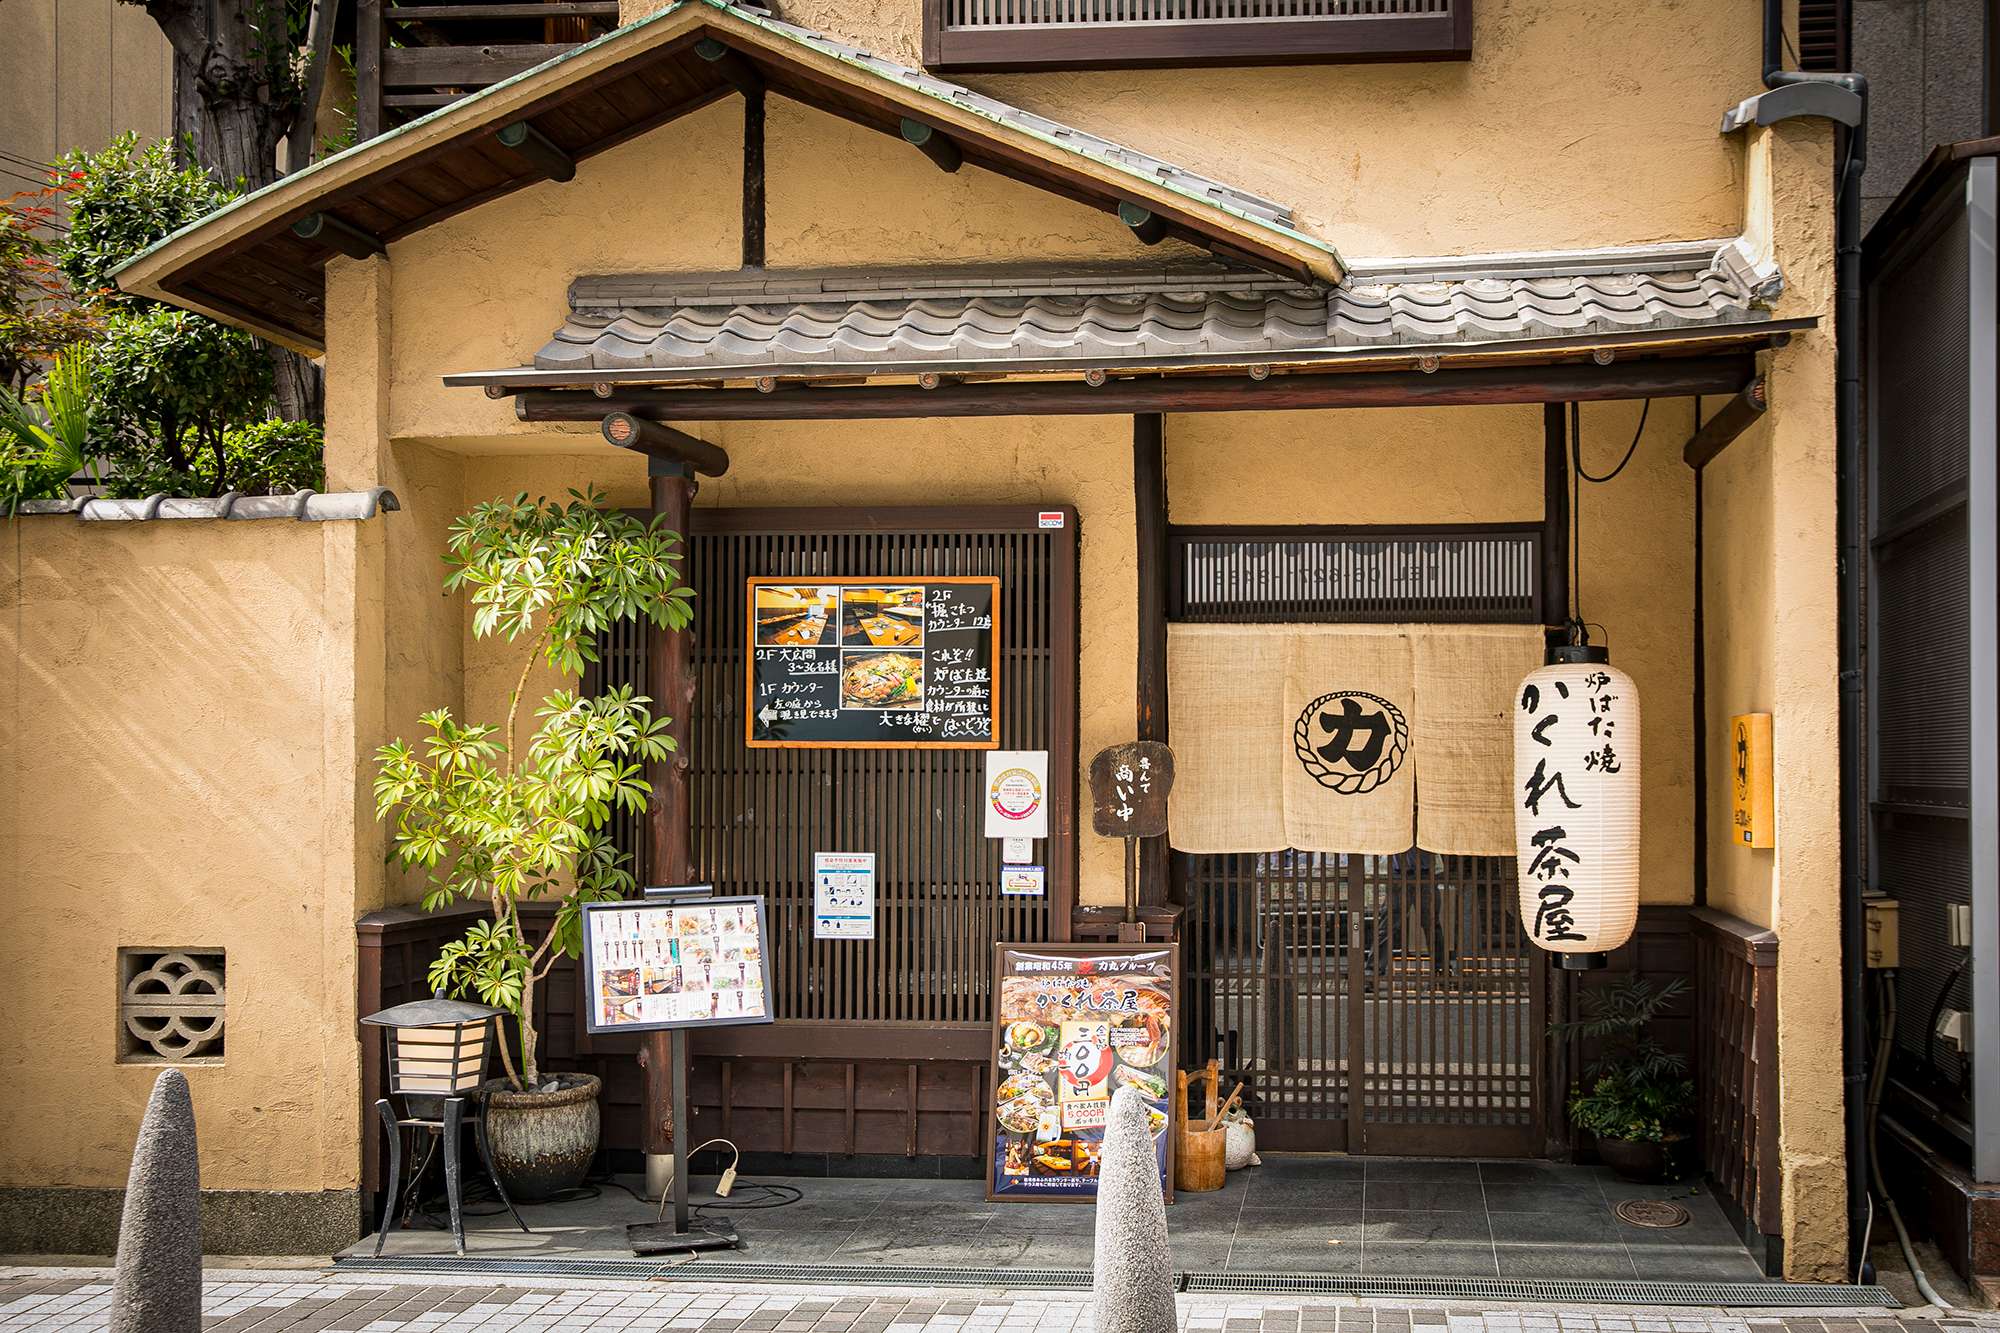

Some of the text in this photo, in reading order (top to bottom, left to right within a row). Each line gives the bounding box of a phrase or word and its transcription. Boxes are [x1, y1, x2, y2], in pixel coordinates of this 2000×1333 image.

[932, 590, 952, 601] 2F
[928, 618, 965, 631] カウンター
[756, 649, 777, 661] 2F
[760, 681, 824, 696] 1F カウンター
[1317, 698, 1391, 771] 力
[1115, 764, 1134, 822] 商い中
[1521, 681, 1588, 941] かくれ茶屋
[1098, 961, 1156, 971] 力丸グループ
[1036, 990, 1139, 1011] かくれ茶屋
